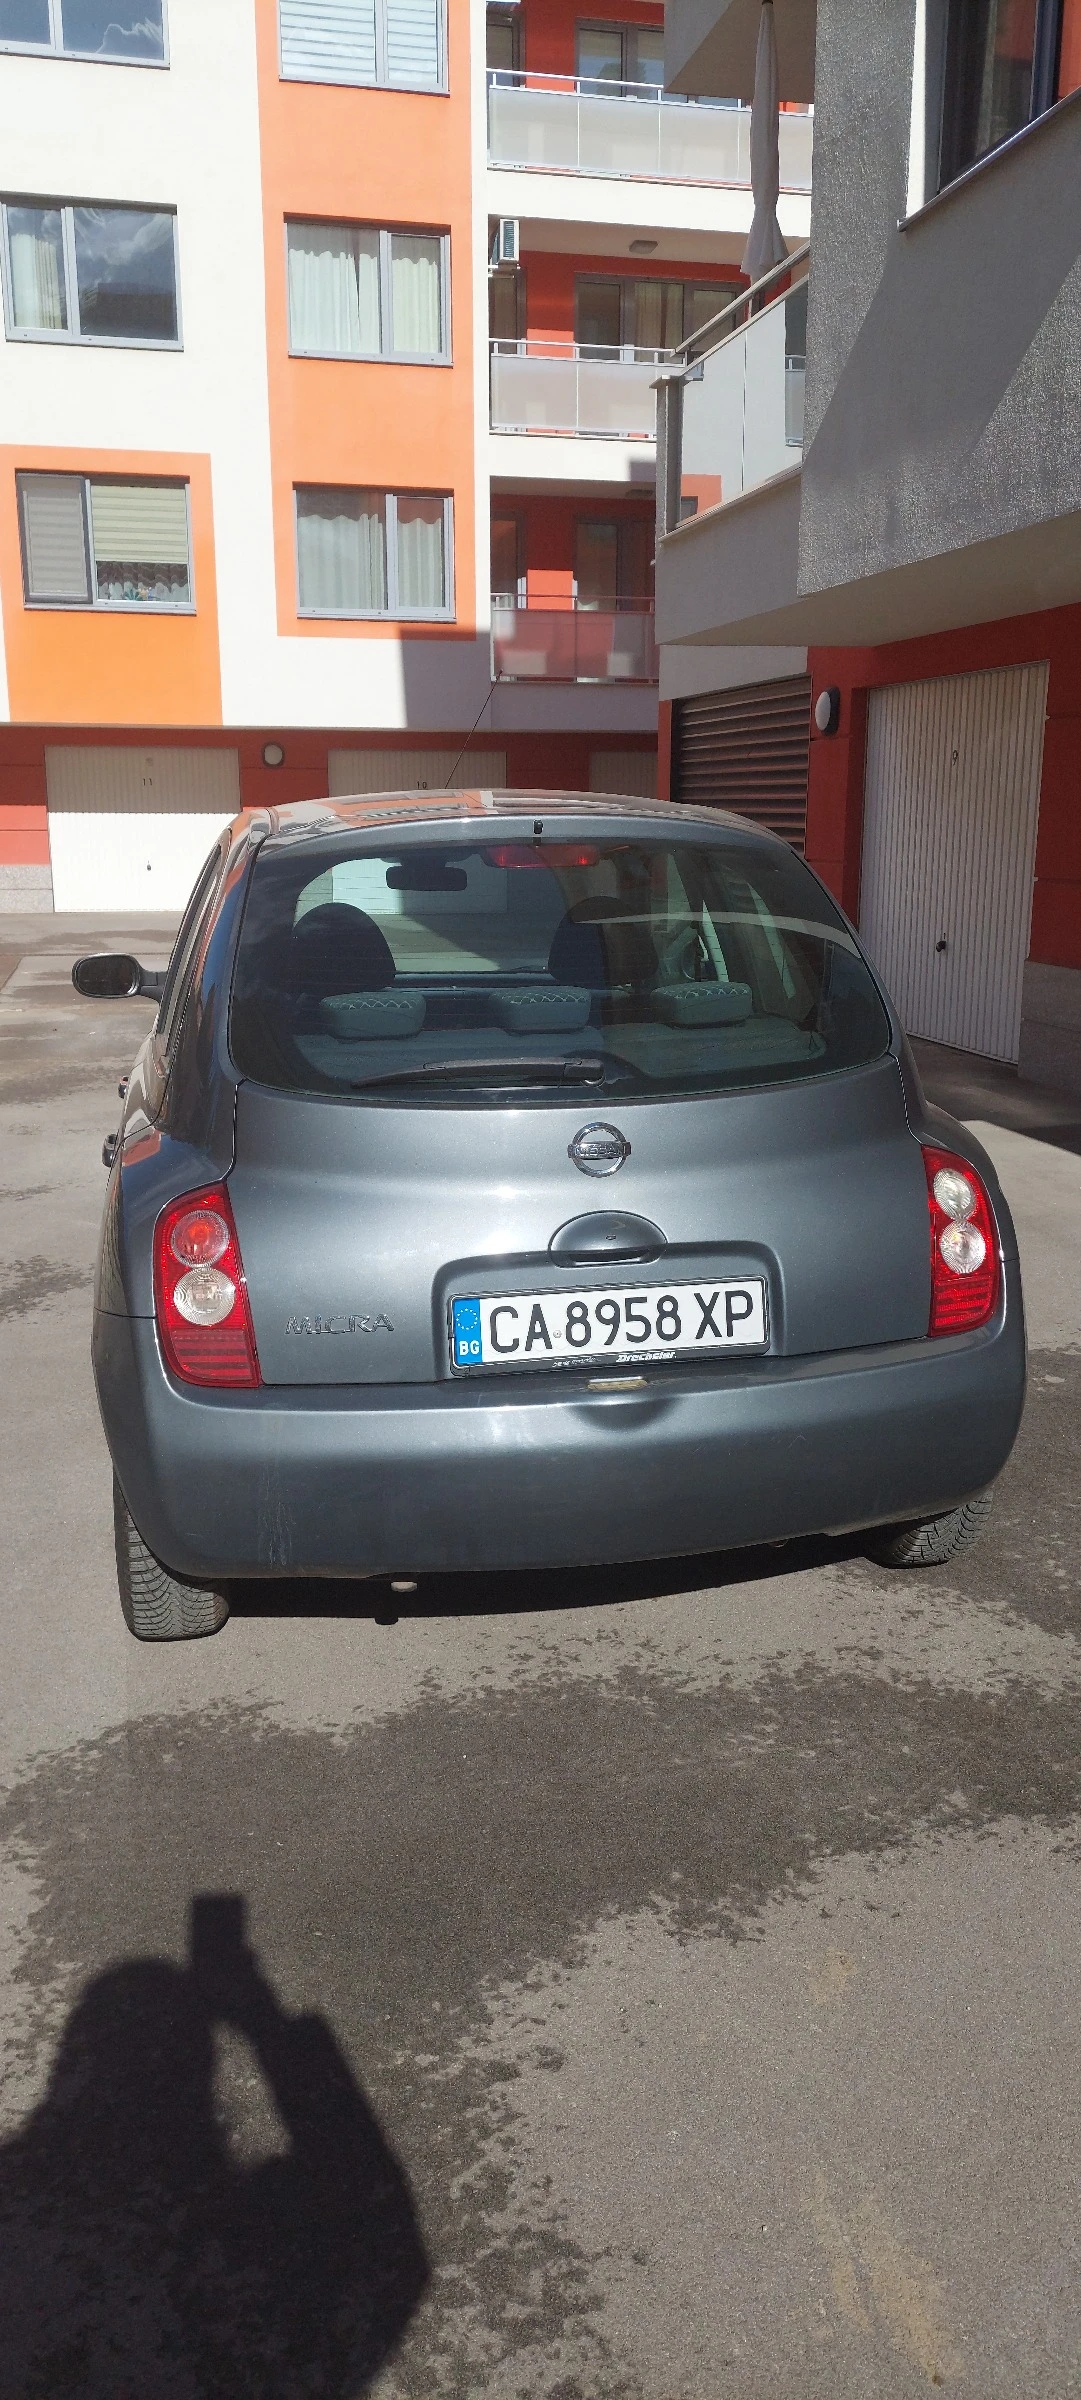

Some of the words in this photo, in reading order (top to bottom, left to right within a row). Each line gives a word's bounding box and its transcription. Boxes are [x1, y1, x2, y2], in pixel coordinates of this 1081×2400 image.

[952, 749, 959, 766] 9
[142, 777, 153, 786] 11
[416, 780, 428, 790] 10
[285, 1313, 395, 1335] MICRA
[490, 1303, 553, 1353] CA
[565, 1294, 682, 1347] 8958
[693, 1289, 754, 1340] XP
[459, 1339, 480, 1356] BG
